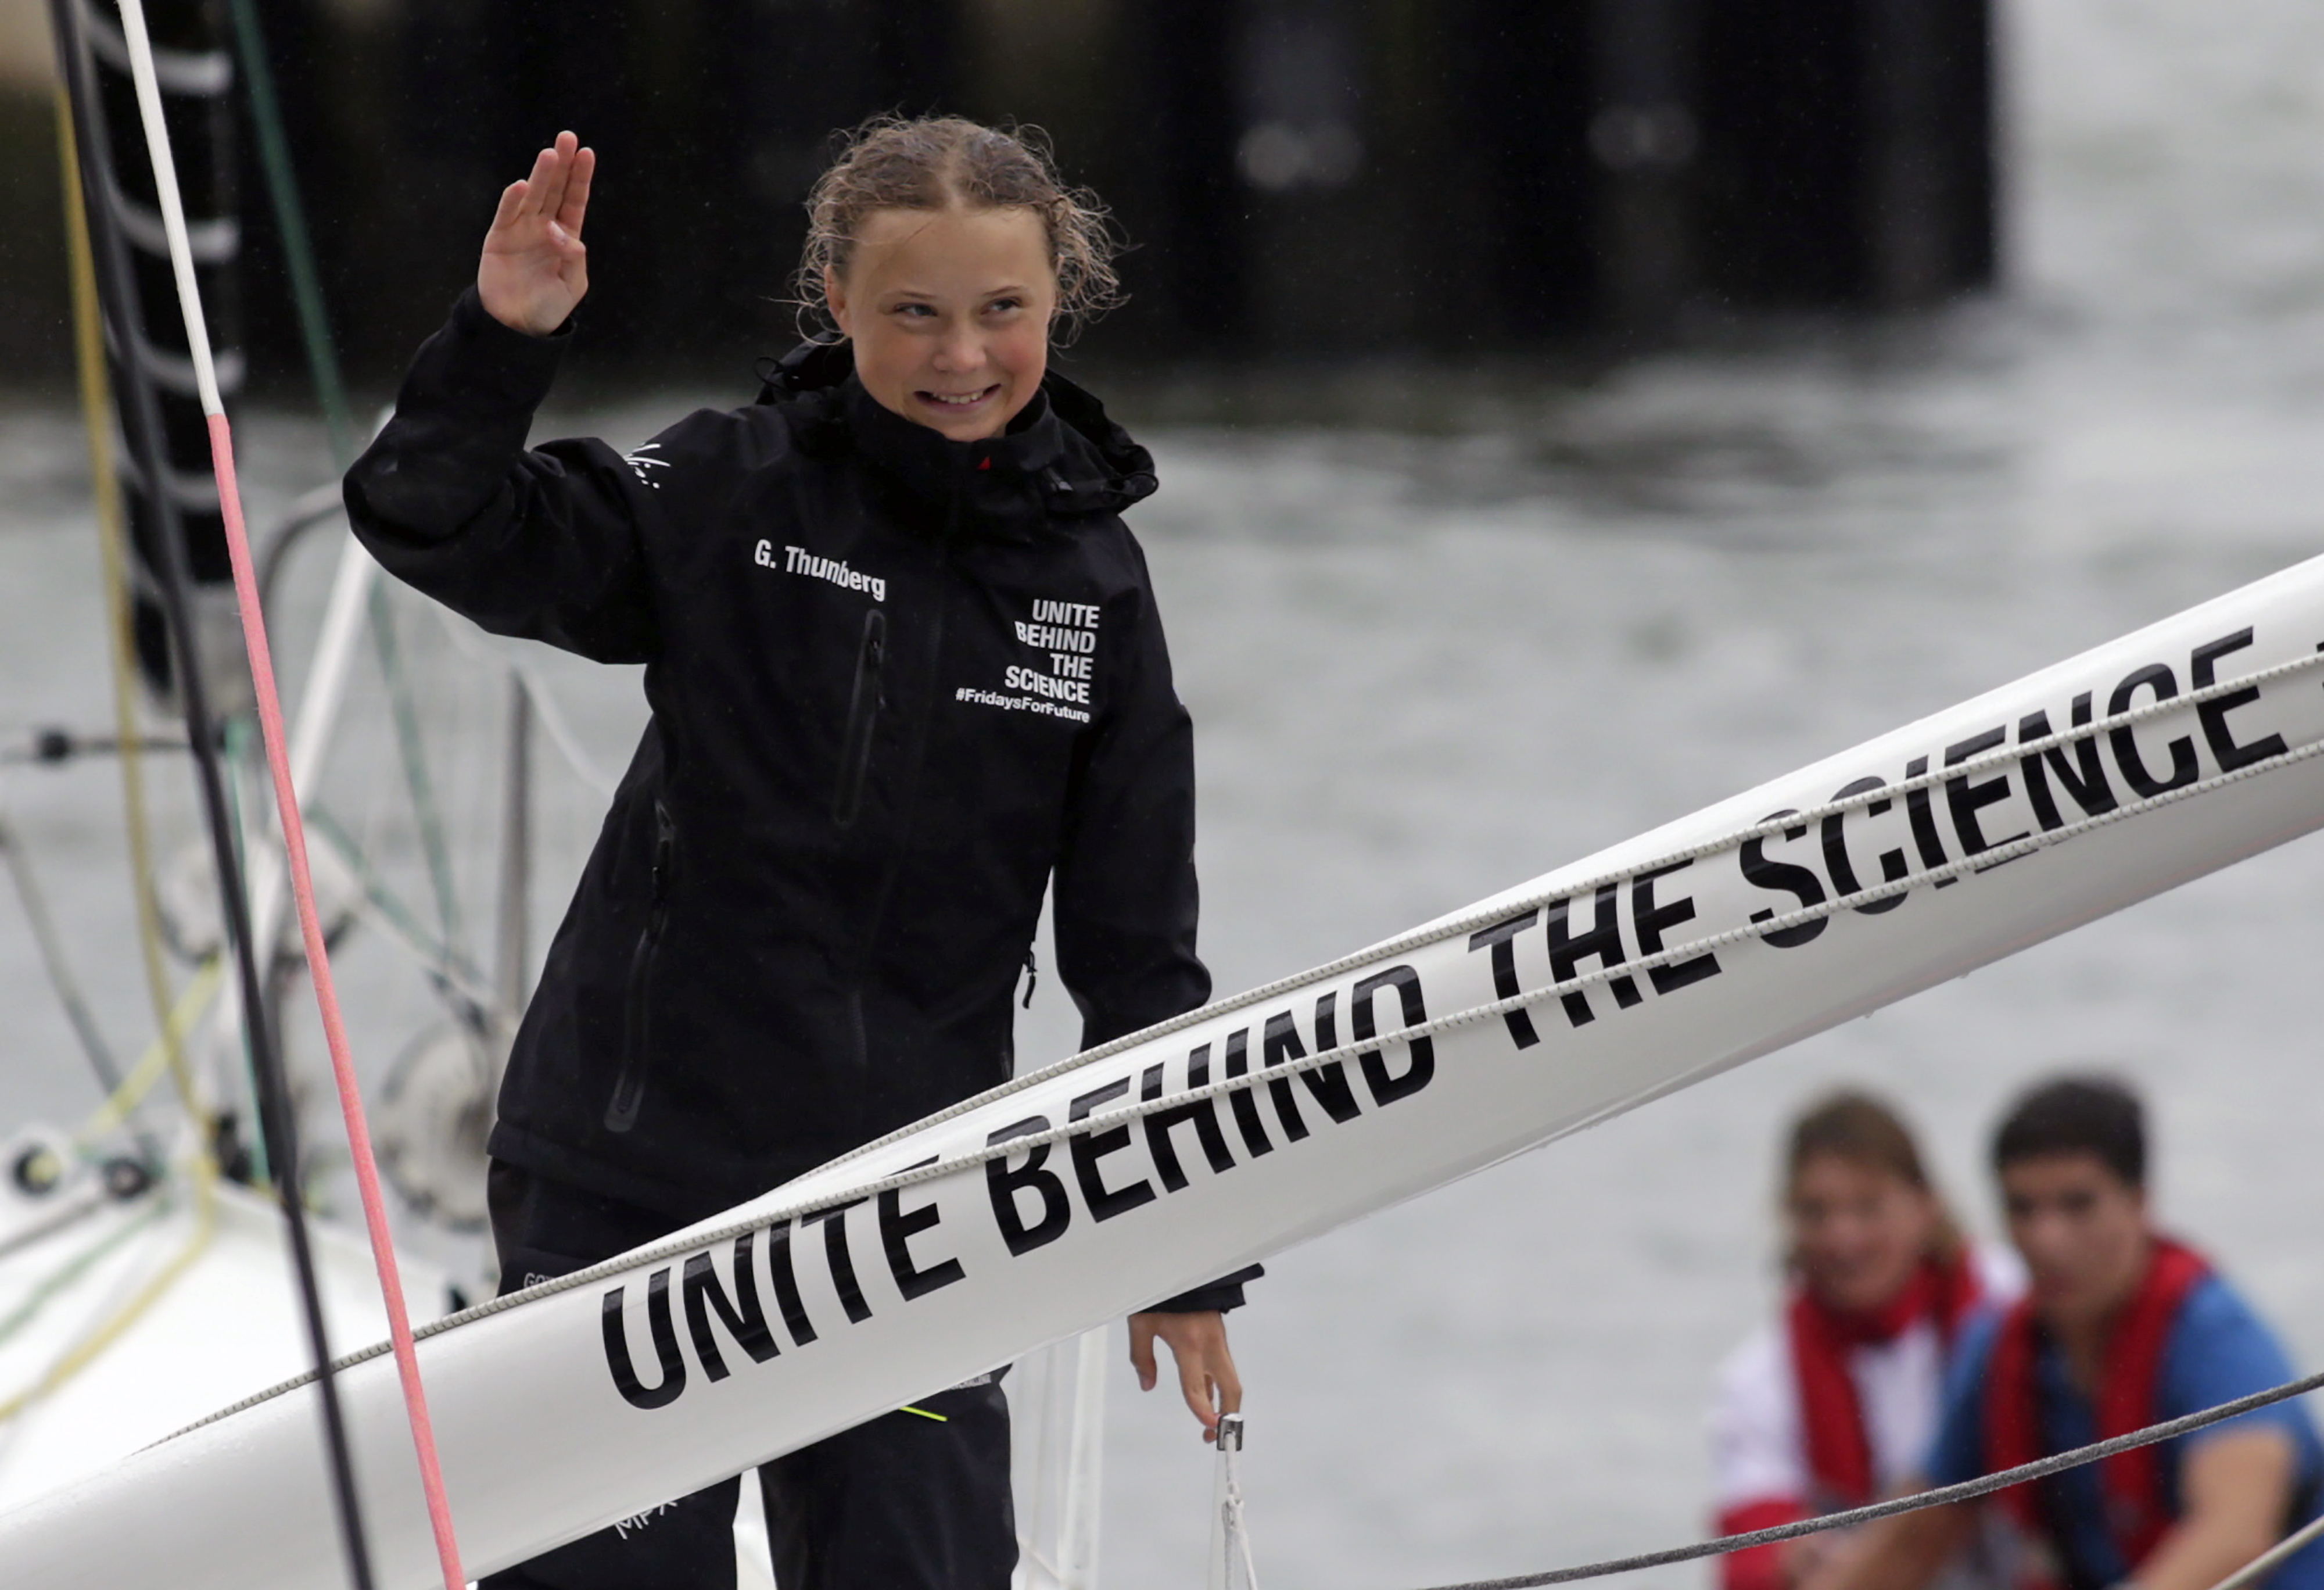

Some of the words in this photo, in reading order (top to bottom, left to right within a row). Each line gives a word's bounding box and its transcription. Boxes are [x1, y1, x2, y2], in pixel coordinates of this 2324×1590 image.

[754, 539, 776, 569] G.
[785, 545, 885, 602] Thunberg
[1032, 599, 1100, 629] UNITE
[1014, 621, 1096, 653] BEHIND
[1005, 665, 1090, 705] SCIENCE
[1049, 653, 1094, 680] THE
[955, 687, 1091, 724] #FridaysForFuture
[602, 1154, 966, 1410] UNITE
[983, 964, 1435, 1257] BEHIND
[1467, 857, 1722, 1051] THE
[1738, 625, 2290, 949] SCIENCE
